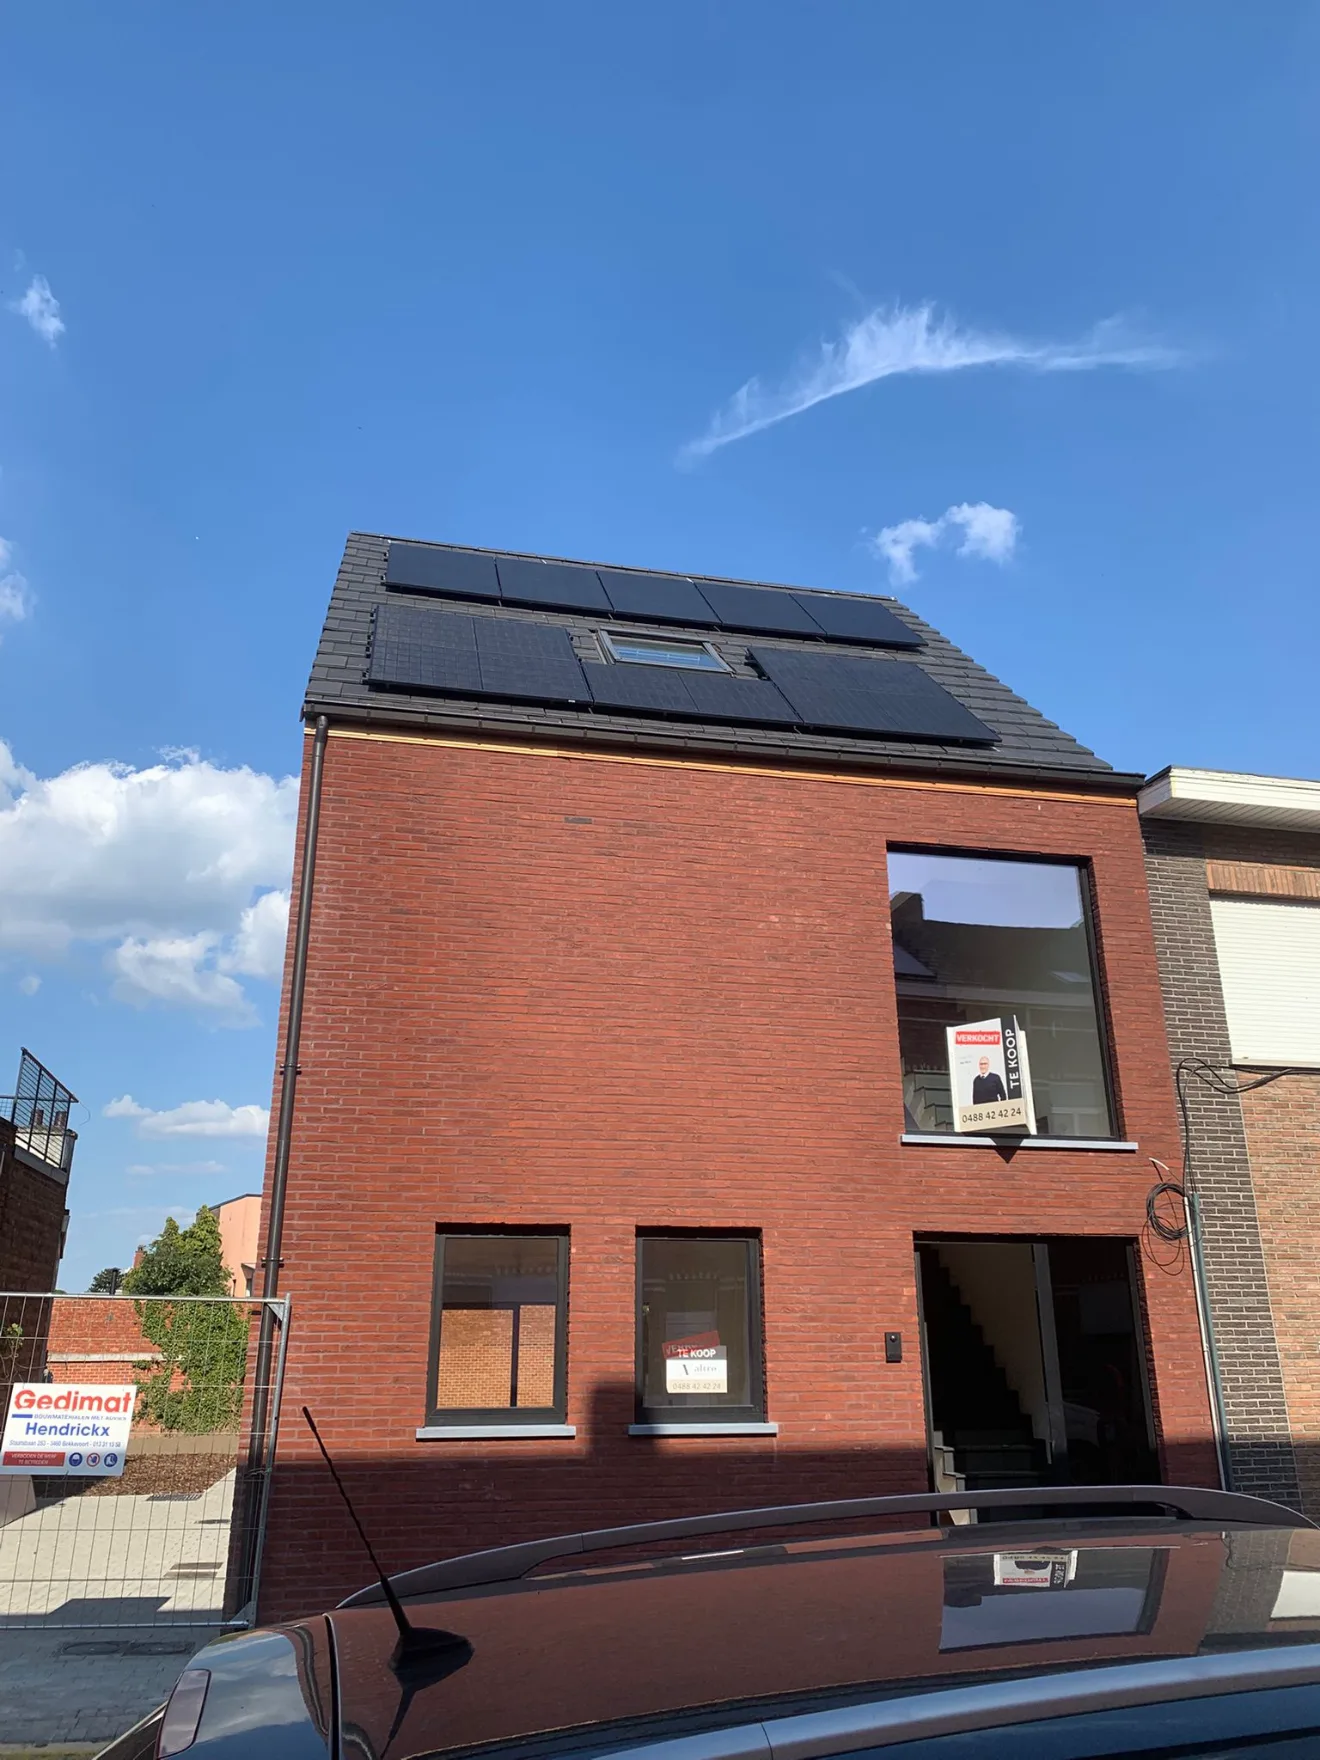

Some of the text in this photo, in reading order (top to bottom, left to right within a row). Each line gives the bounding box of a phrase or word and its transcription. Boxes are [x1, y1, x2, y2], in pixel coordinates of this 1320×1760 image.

[956, 1034, 999, 1043] VERKOCHT
[1005, 1028, 1020, 1089] TE KOOP
[962, 1107, 1022, 1123] 0488 42 42 24
[677, 1349, 689, 1358] TE
[690, 1348, 716, 1358] KOOP
[692, 1382, 701, 1390] 42
[702, 1382, 711, 1390] 42
[14, 1389, 132, 1413] Gedimat
[25, 1422, 111, 1436] Hendrickx
